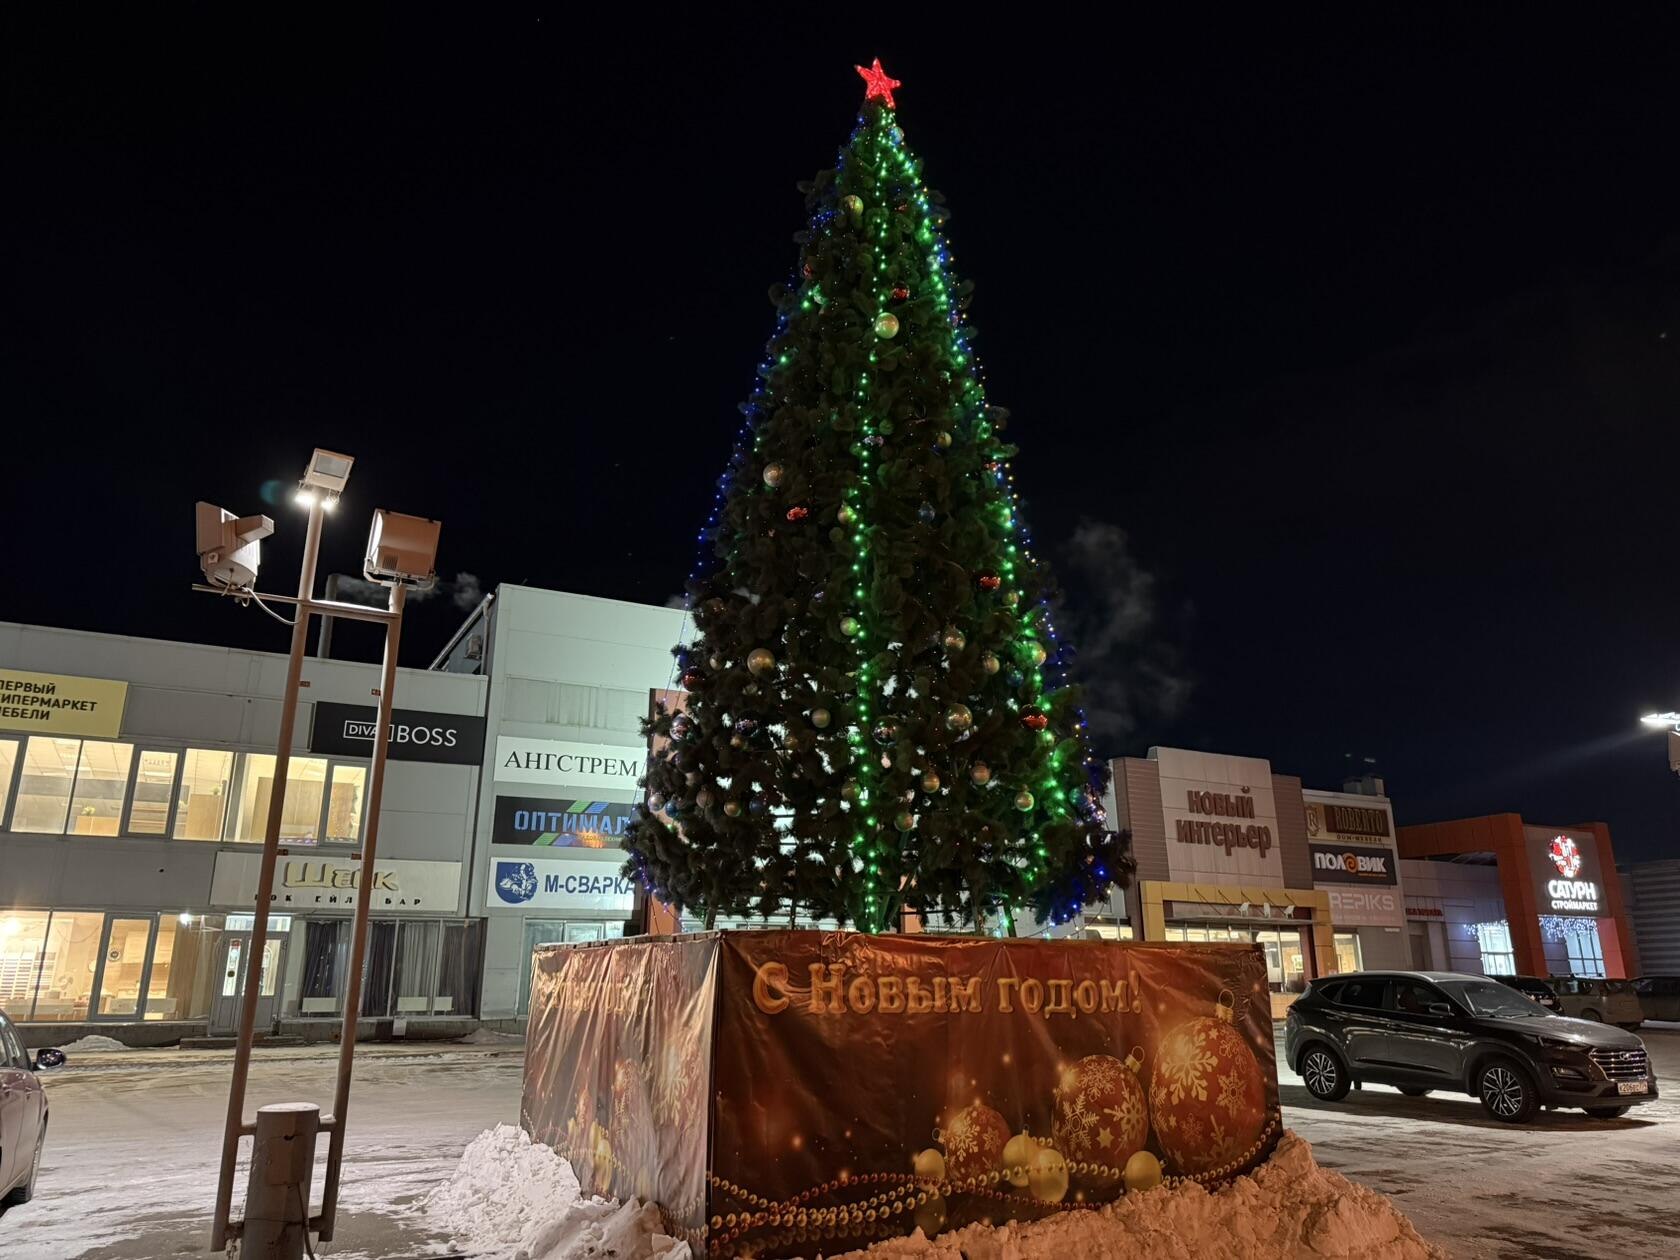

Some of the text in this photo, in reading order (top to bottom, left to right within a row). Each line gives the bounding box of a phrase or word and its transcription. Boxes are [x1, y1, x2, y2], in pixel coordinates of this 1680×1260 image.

[0, 692, 98, 711] ИПЕРМАРКЕТ
[0, 706, 50, 721] ЕБЕЛИ
[348, 724, 457, 746] DIVA BOSS
[504, 750, 638, 777] АНГСТРЕМ
[1334, 806, 1384, 833] ROBERTO
[1176, 819, 1271, 858] интерьер
[1314, 852, 1387, 873] ПОЛОВИК
[544, 874, 635, 895] М-СВАРКА
[1548, 880, 1597, 900] САТУРН
[385, 898, 422, 906] БАР
[1328, 892, 1395, 911] REPIKS
[1551, 900, 1598, 911] СТРОЙМАРКЕТ
[753, 961, 790, 1015] С
